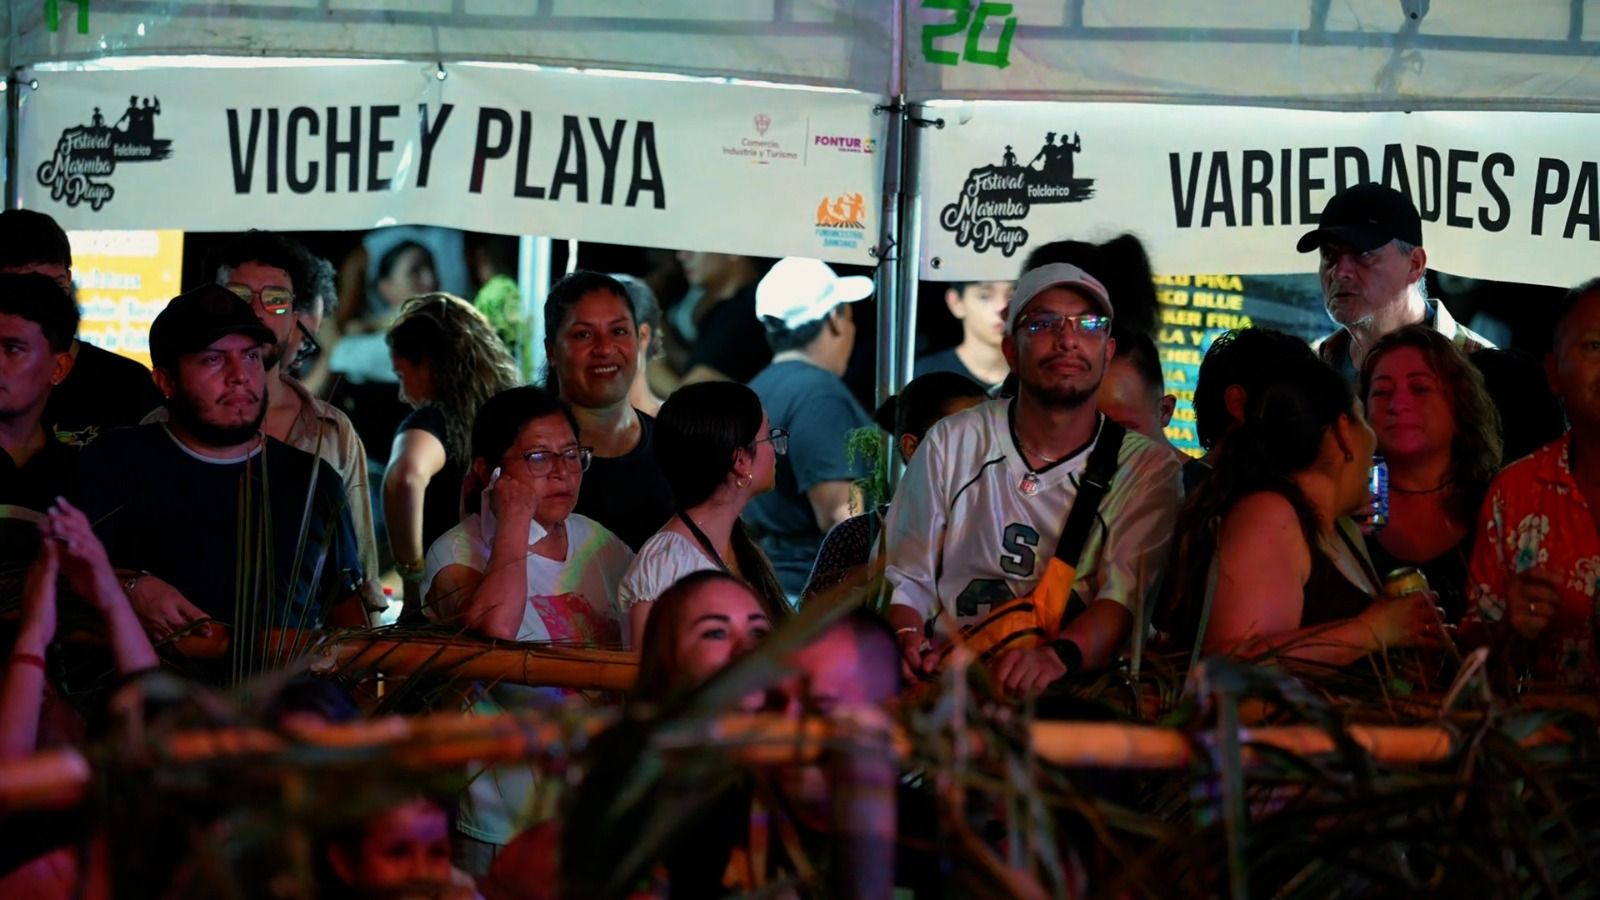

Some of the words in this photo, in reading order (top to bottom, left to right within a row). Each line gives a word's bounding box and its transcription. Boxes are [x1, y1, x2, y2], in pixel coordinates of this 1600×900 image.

[921, 0, 1017, 69] 20
[60, 131, 112, 156] Festival
[226, 105, 401, 195] VICHE
[415, 102, 456, 188] Y
[469, 106, 667, 210] PLAYA
[814, 135, 862, 149] FONTUR
[41, 153, 112, 183] Marimba
[967, 170, 1025, 198] Festival
[54, 176, 65, 199] y
[65, 174, 111, 208] Playa
[943, 194, 1026, 228] Marimba
[959, 219, 971, 243] y
[973, 217, 1025, 253] Playa
[1192, 291, 1244, 311] BLUE
[1000, 522, 1040, 578] S
